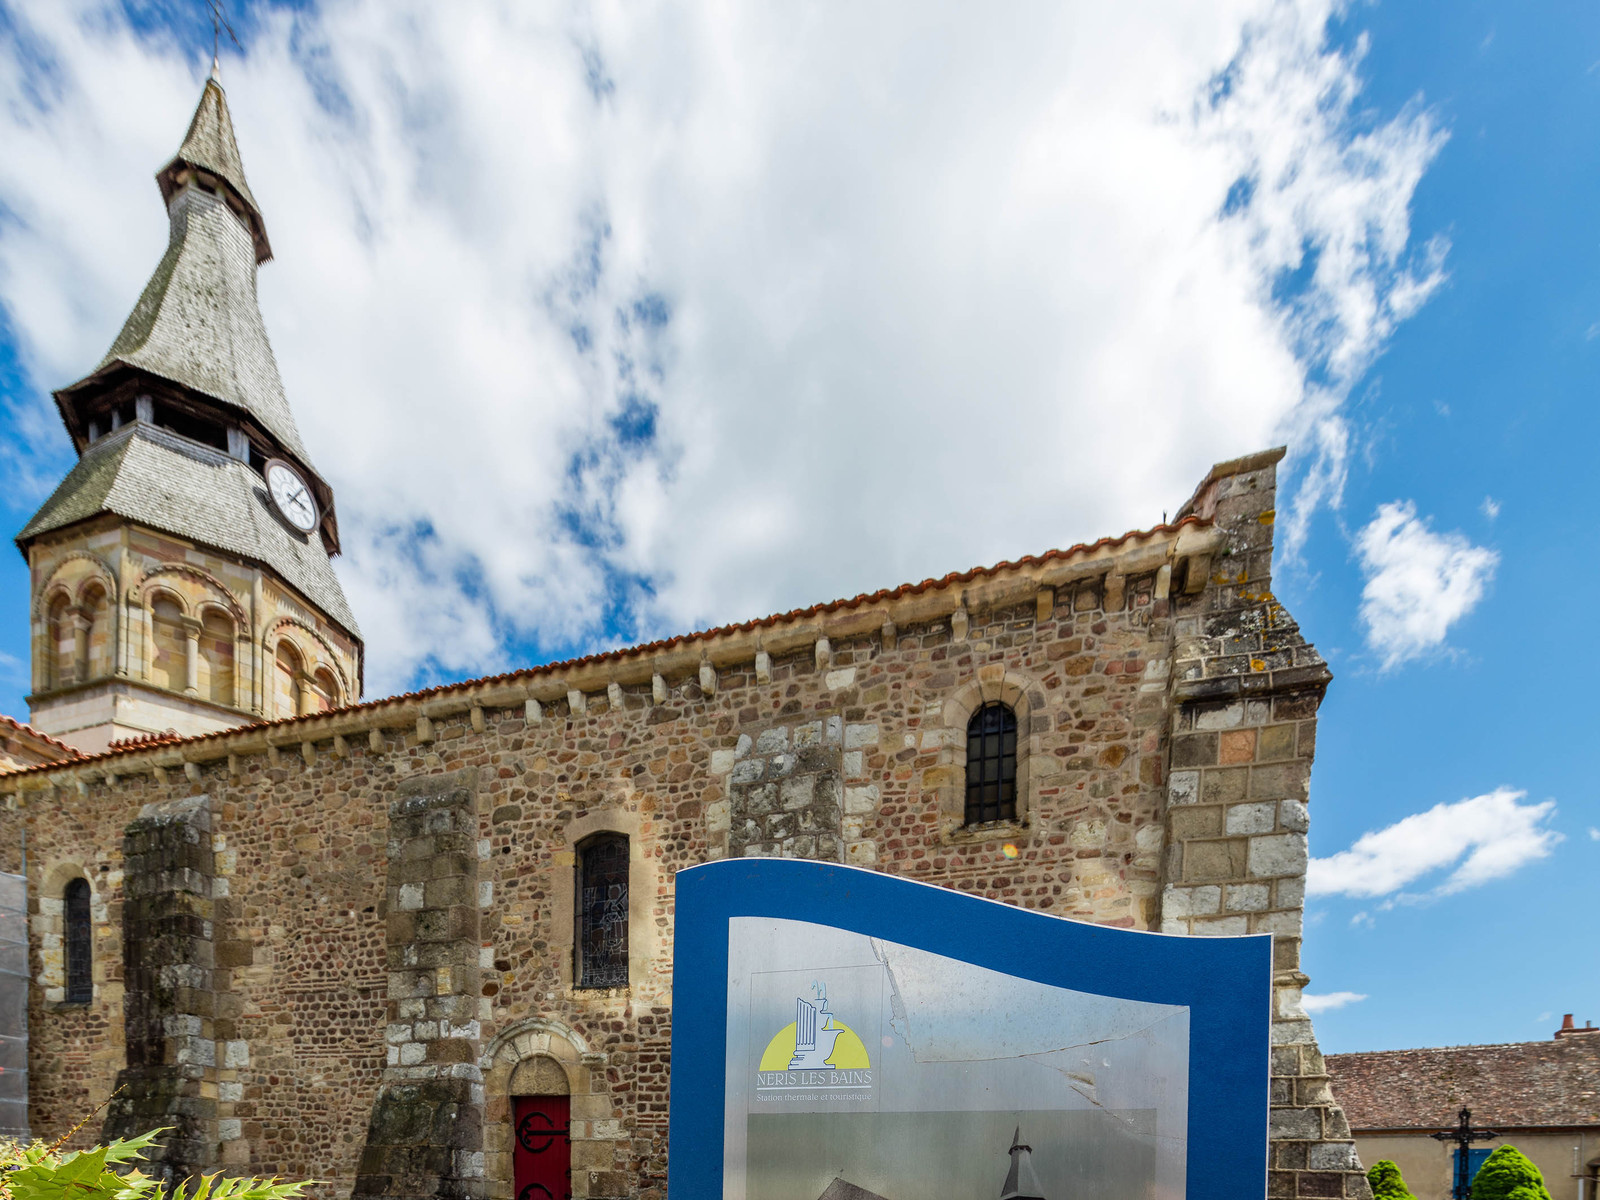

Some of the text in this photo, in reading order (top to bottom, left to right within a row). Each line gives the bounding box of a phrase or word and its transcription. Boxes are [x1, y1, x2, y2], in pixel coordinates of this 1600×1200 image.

[757, 1071, 872, 1086] NERIS LES BAINS
